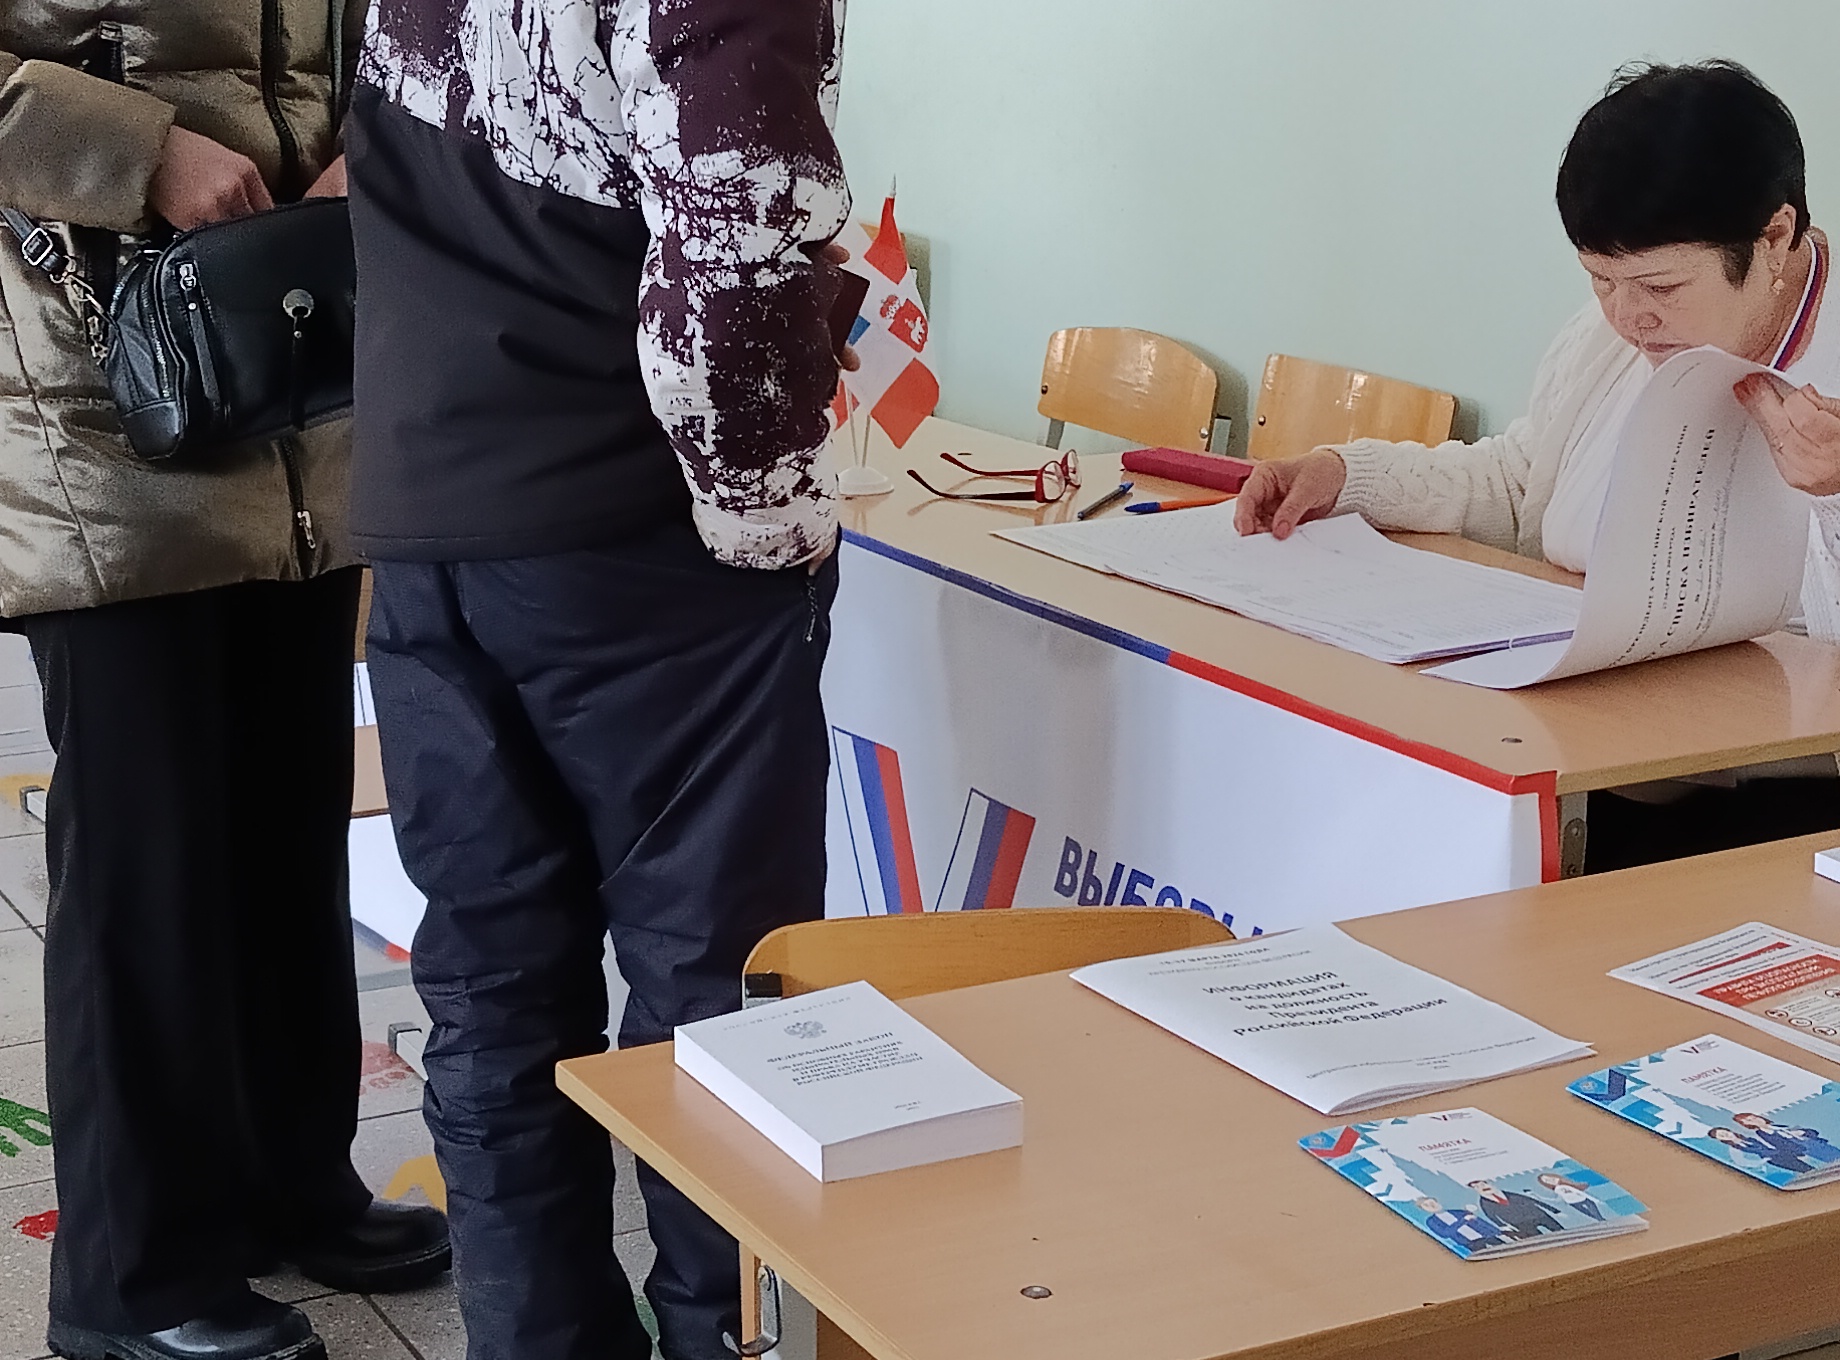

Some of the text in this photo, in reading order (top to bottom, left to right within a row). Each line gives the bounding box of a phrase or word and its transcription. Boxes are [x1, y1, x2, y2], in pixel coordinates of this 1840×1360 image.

[1650, 499, 1667, 581] РОССИЙСКОЙ
[1665, 425, 1688, 496] ФЕДЕРАЦИИ
[1666, 565, 1688, 636] СПИСКА
[1682, 429, 1715, 557] ИЗБИРАТЕЛЕЙ
[1054, 836, 1263, 936] ВЫБ
[1201, 970, 1340, 995] ИНФОРМАЦИЯ
[1229, 981, 1350, 1002] о кандидатах
[1244, 990, 1369, 1011] на должность
[1268, 1000, 1380, 1021] Президента
[1343, 997, 1448, 1022] Федерации
[1681, 1066, 1728, 1084] ПАМЯТКА
[1418, 1138, 1472, 1152] ПАМЯТКА
